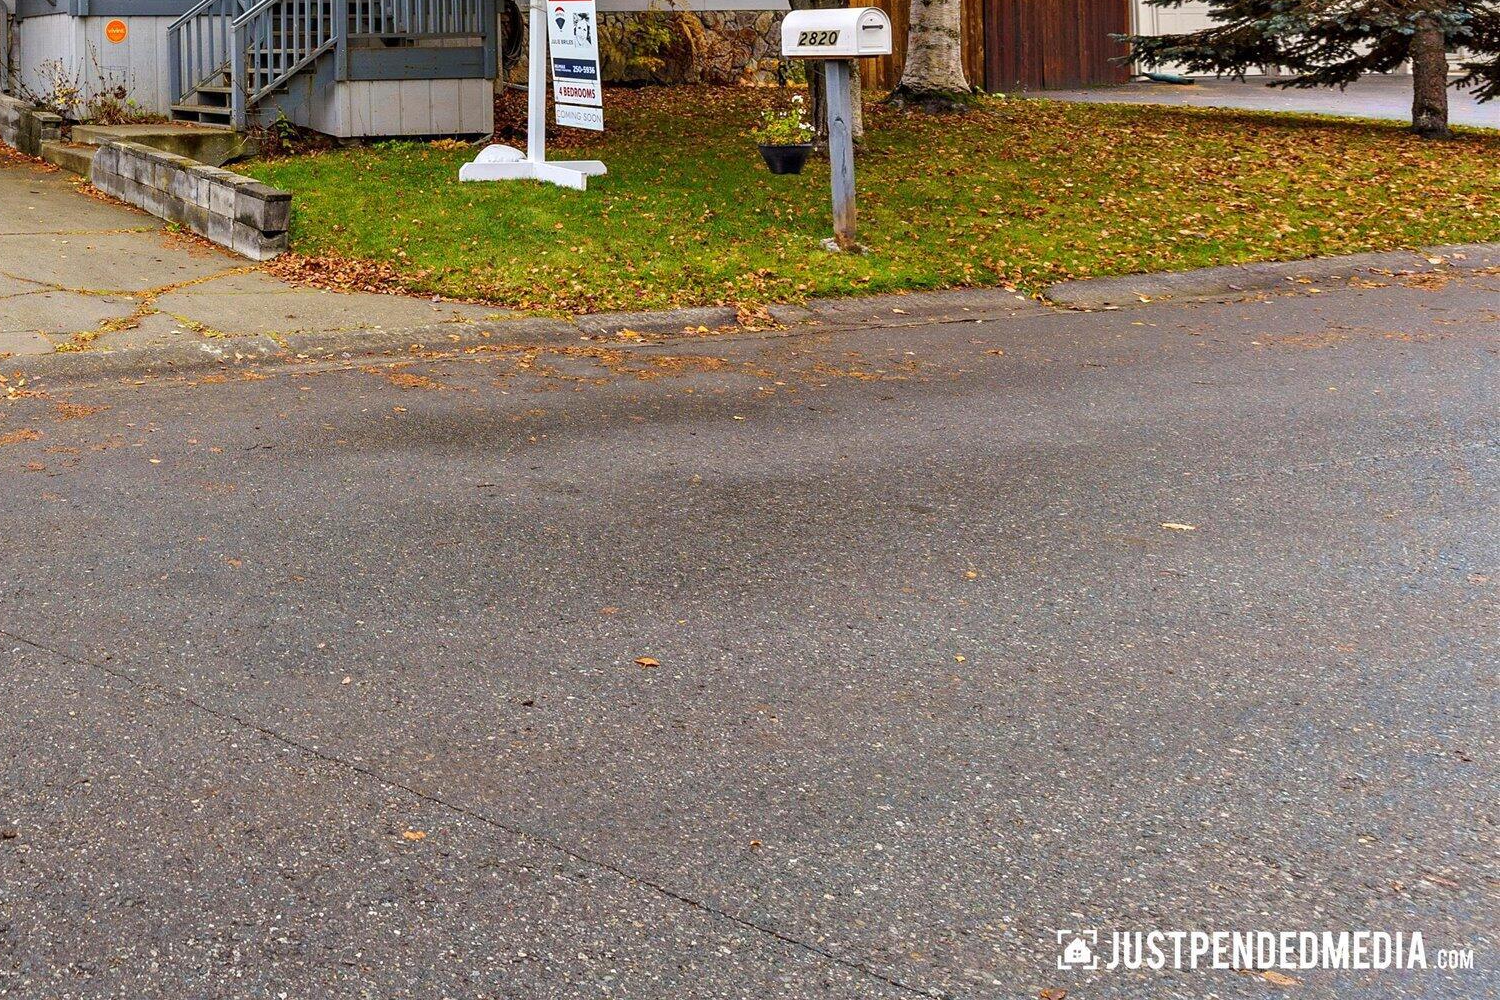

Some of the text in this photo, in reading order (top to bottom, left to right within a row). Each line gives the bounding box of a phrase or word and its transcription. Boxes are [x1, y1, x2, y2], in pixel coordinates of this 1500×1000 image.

[798, 31, 838, 46] 2820
[559, 86, 596, 99] 4 BEDROOMS
[556, 109, 602, 123] COMING SOON
